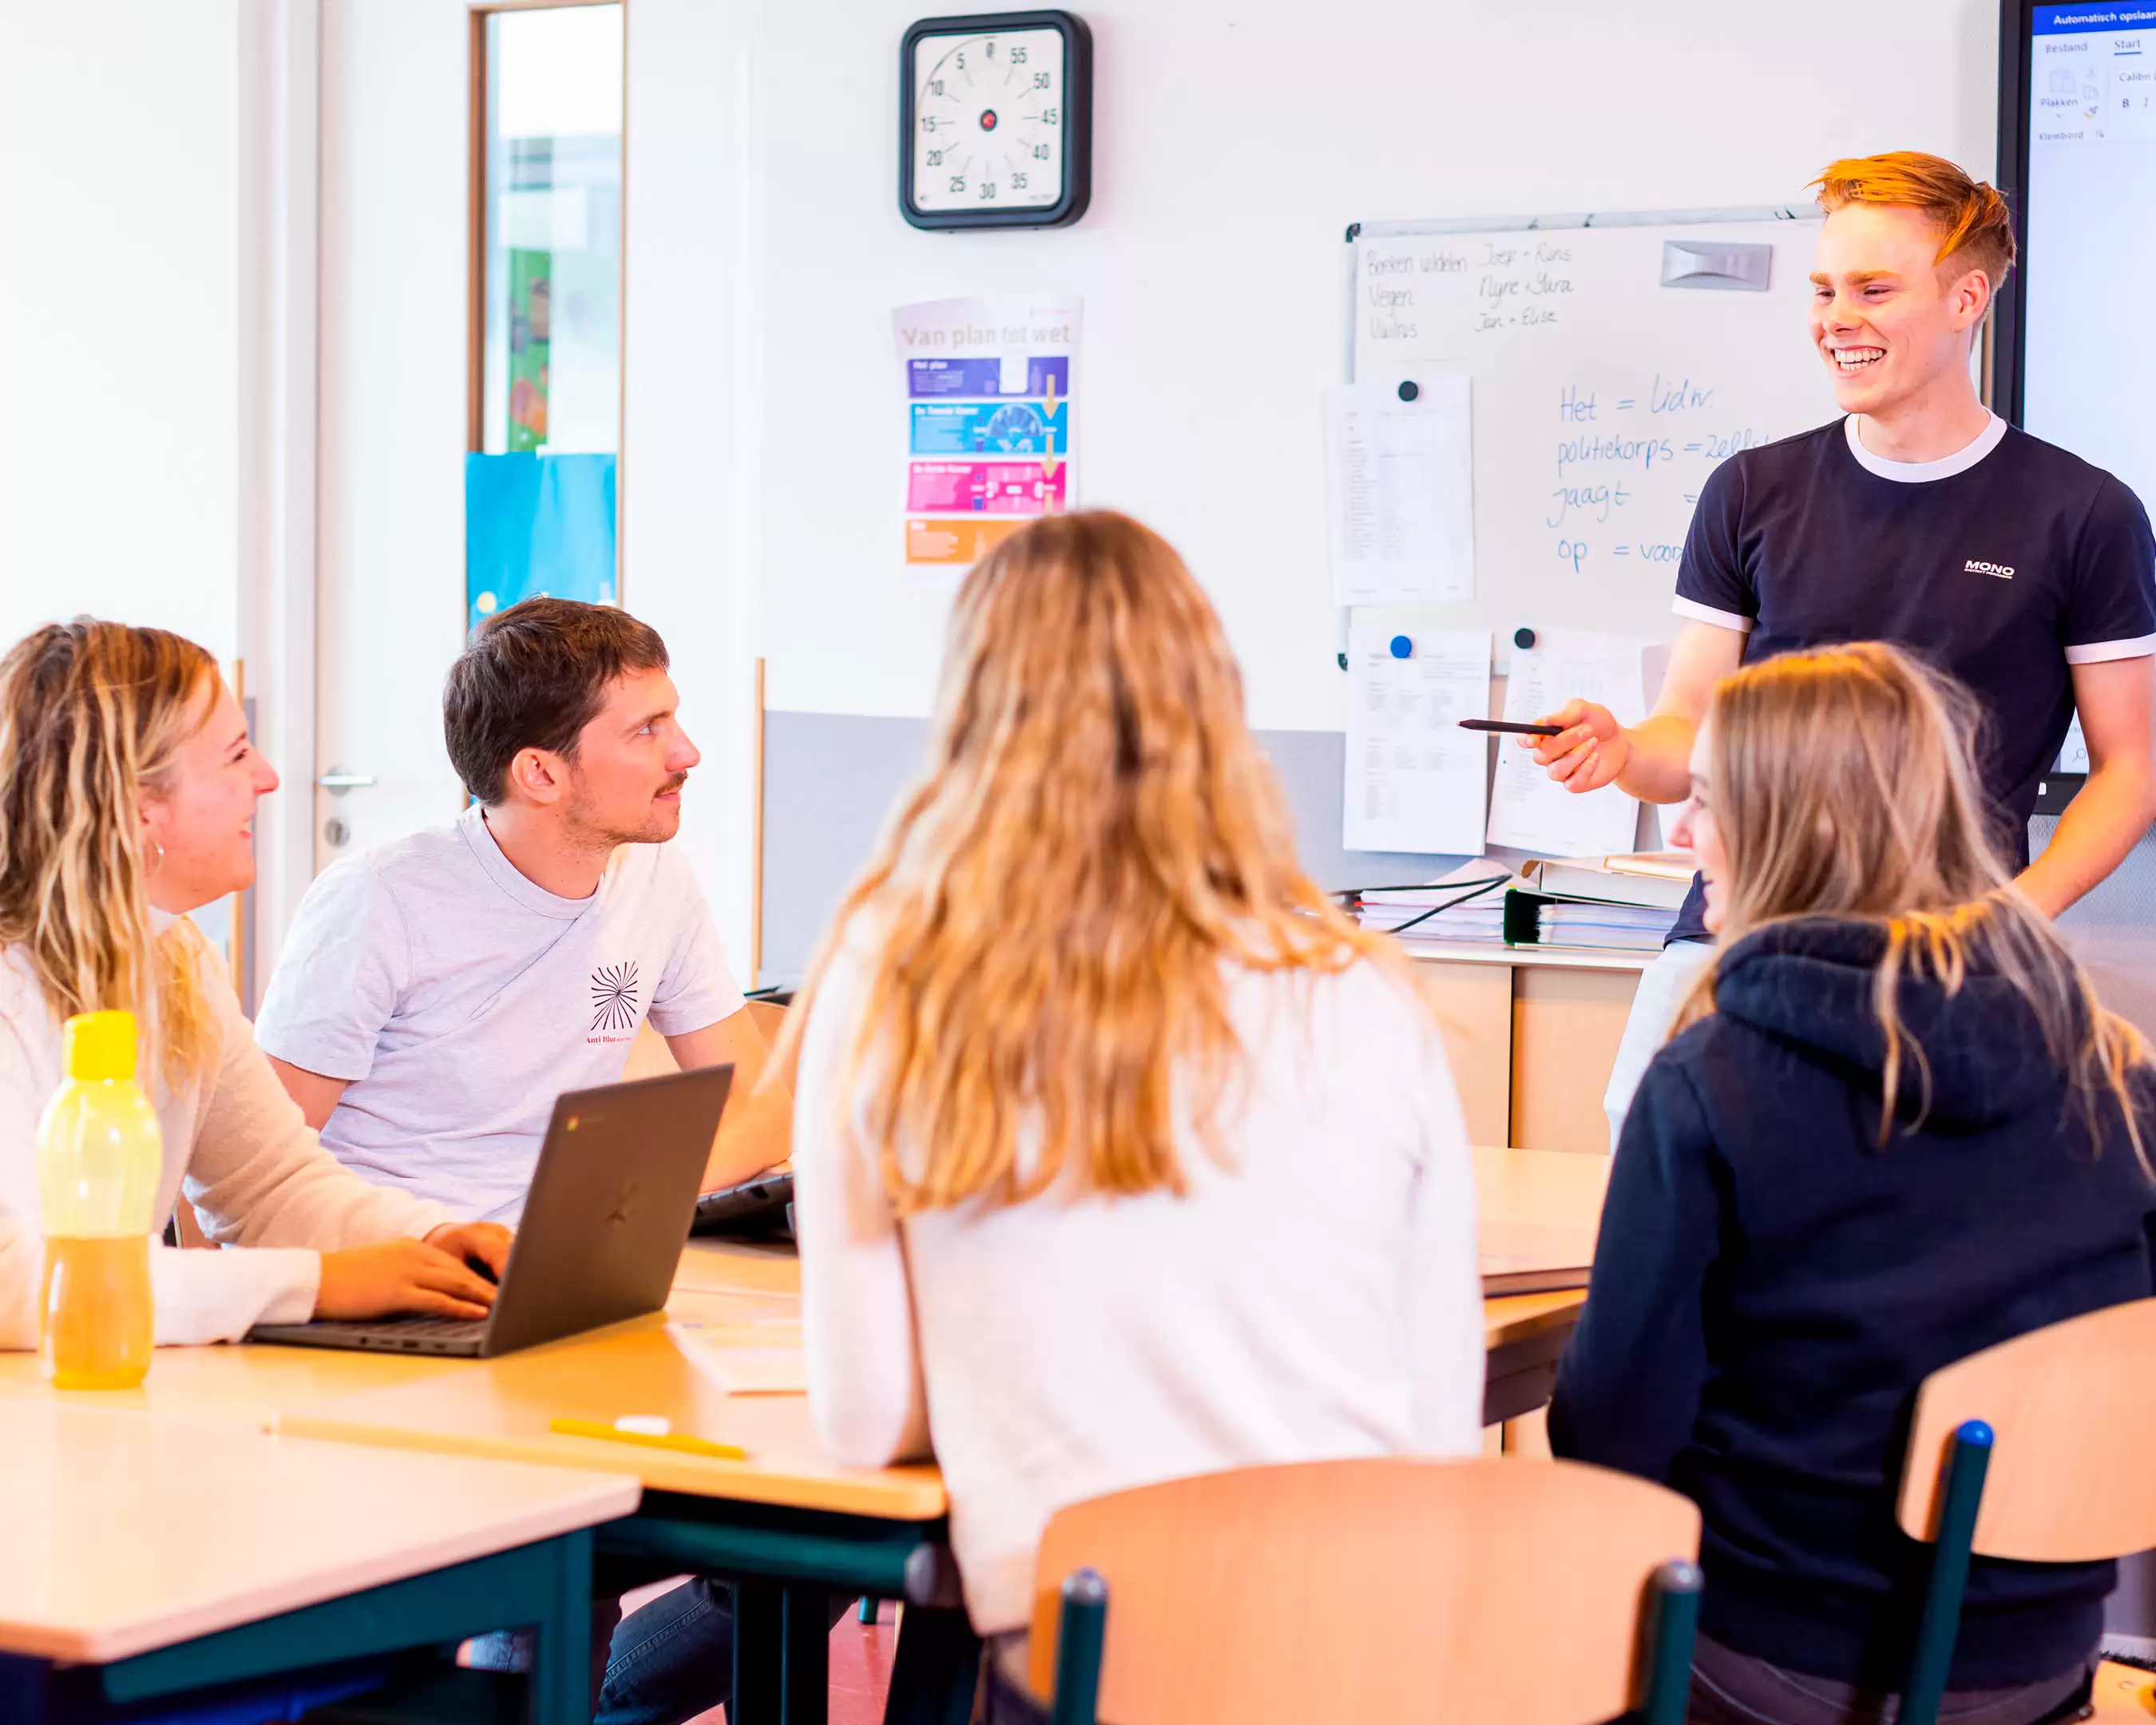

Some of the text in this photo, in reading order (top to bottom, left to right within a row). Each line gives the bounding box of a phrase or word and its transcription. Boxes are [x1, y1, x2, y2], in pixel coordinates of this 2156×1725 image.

[2054, 12, 2117, 25] Automatisch
[985, 42, 994, 58] 0
[2045, 42, 2089, 54] Bestand
[2114, 39, 2142, 50] Start
[957, 53, 965, 69] 5
[1010, 46, 1028, 64] 55
[1033, 72, 1050, 89] 50
[2118, 71, 2150, 81] Calibri
[930, 80, 945, 96] 10
[2040, 97, 2079, 108] Plakken
[921, 116, 936, 133] 15
[1041, 108, 1057, 125] 45
[2039, 131, 2084, 141] Klembord
[926, 149, 943, 166] 20
[1032, 144, 1049, 161] 40
[949, 175, 965, 192] 25
[1011, 172, 1028, 189] 35
[979, 183, 997, 200] 30
[902, 324, 1071, 351] Van plan tot wet
[1560, 384, 1598, 422] Het
[1557, 434, 1674, 479] politiekorps
[1546, 480, 1634, 529] jaagt
[1557, 539, 1588, 573] op
[1964, 560, 2015, 576] MONO
[587, 1035, 601, 1044] Anti
